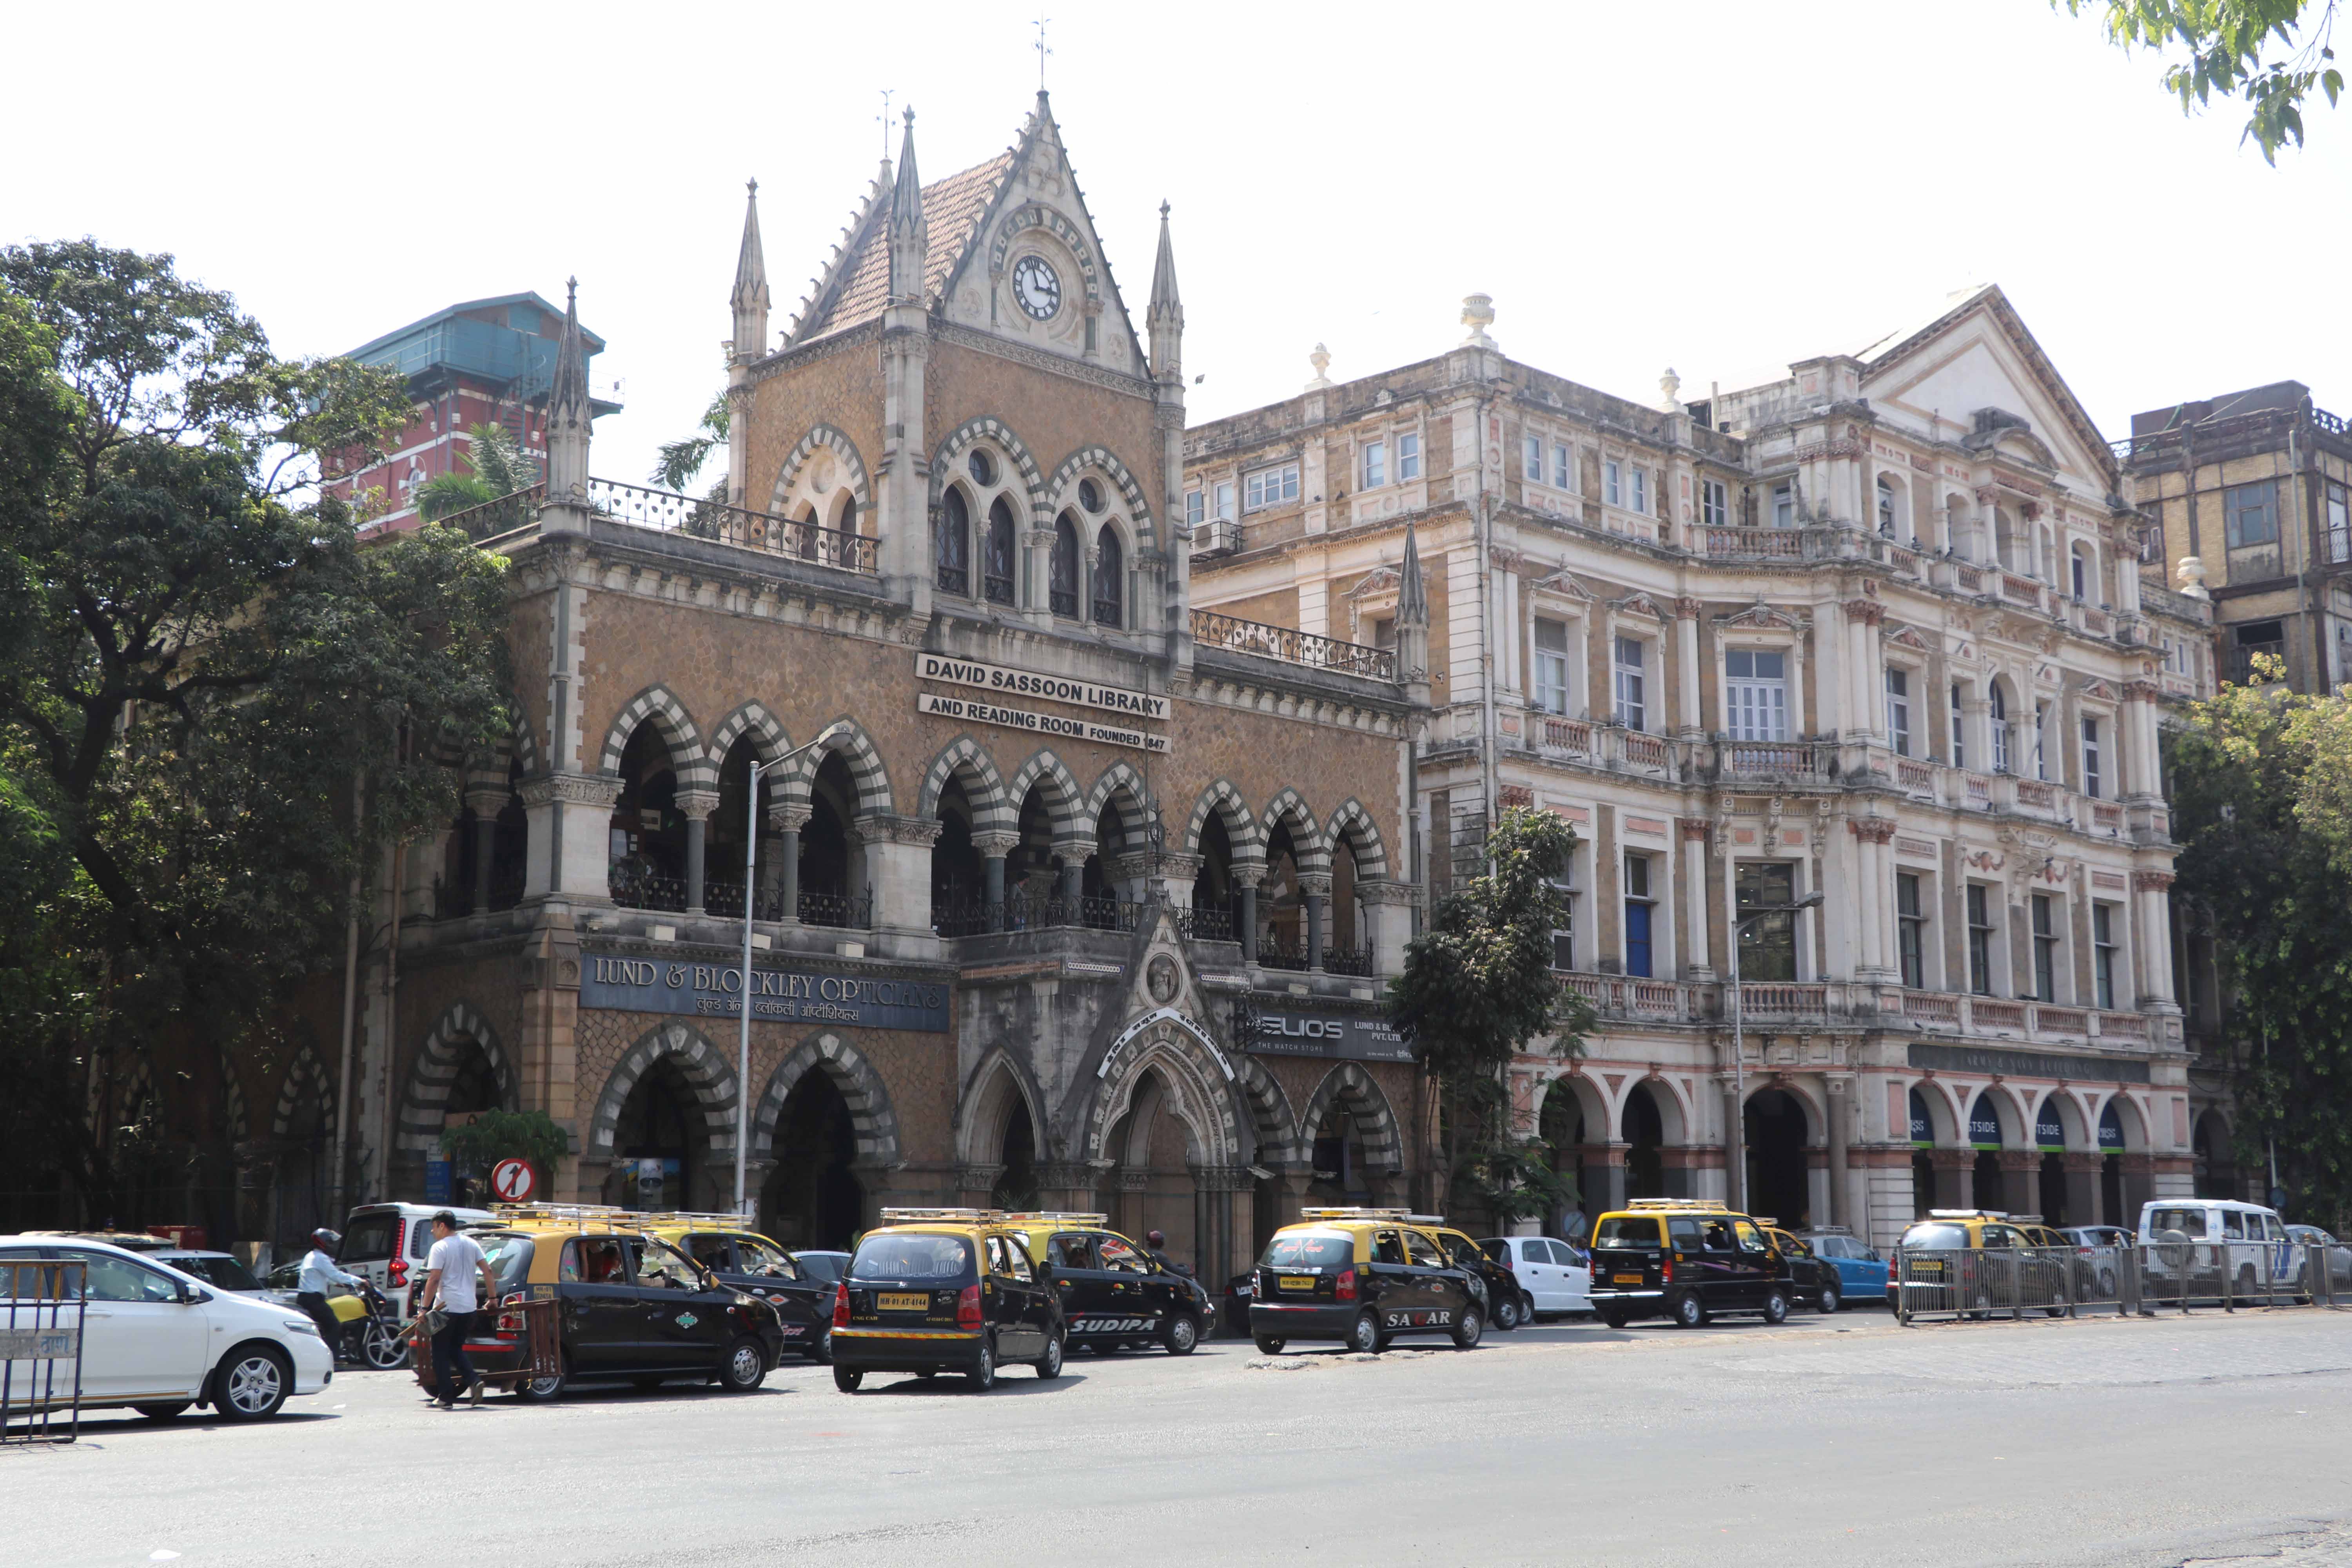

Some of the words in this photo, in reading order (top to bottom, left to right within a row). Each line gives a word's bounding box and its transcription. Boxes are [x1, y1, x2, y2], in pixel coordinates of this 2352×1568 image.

[926, 659, 985, 683] DAVID
[991, 671, 1082, 701] SASSOON
[1088, 688, 1163, 715] LIBRARY
[929, 698, 963, 715] AND
[967, 704, 1036, 728] READING
[1041, 717, 1083, 736] ROOM
[1090, 727, 1140, 745] FOUNDED
[595, 958, 657, 985] LUND
[666, 964, 686, 988] &
[693, 965, 814, 998] BLOCKLEY
[820, 978, 940, 1009] OPTICIANS
[1355, 1021, 1374, 1030] LUND
[1372, 1032, 1387, 1041] PVT.
[1069, 1319, 1156, 1332] SUDIPA
